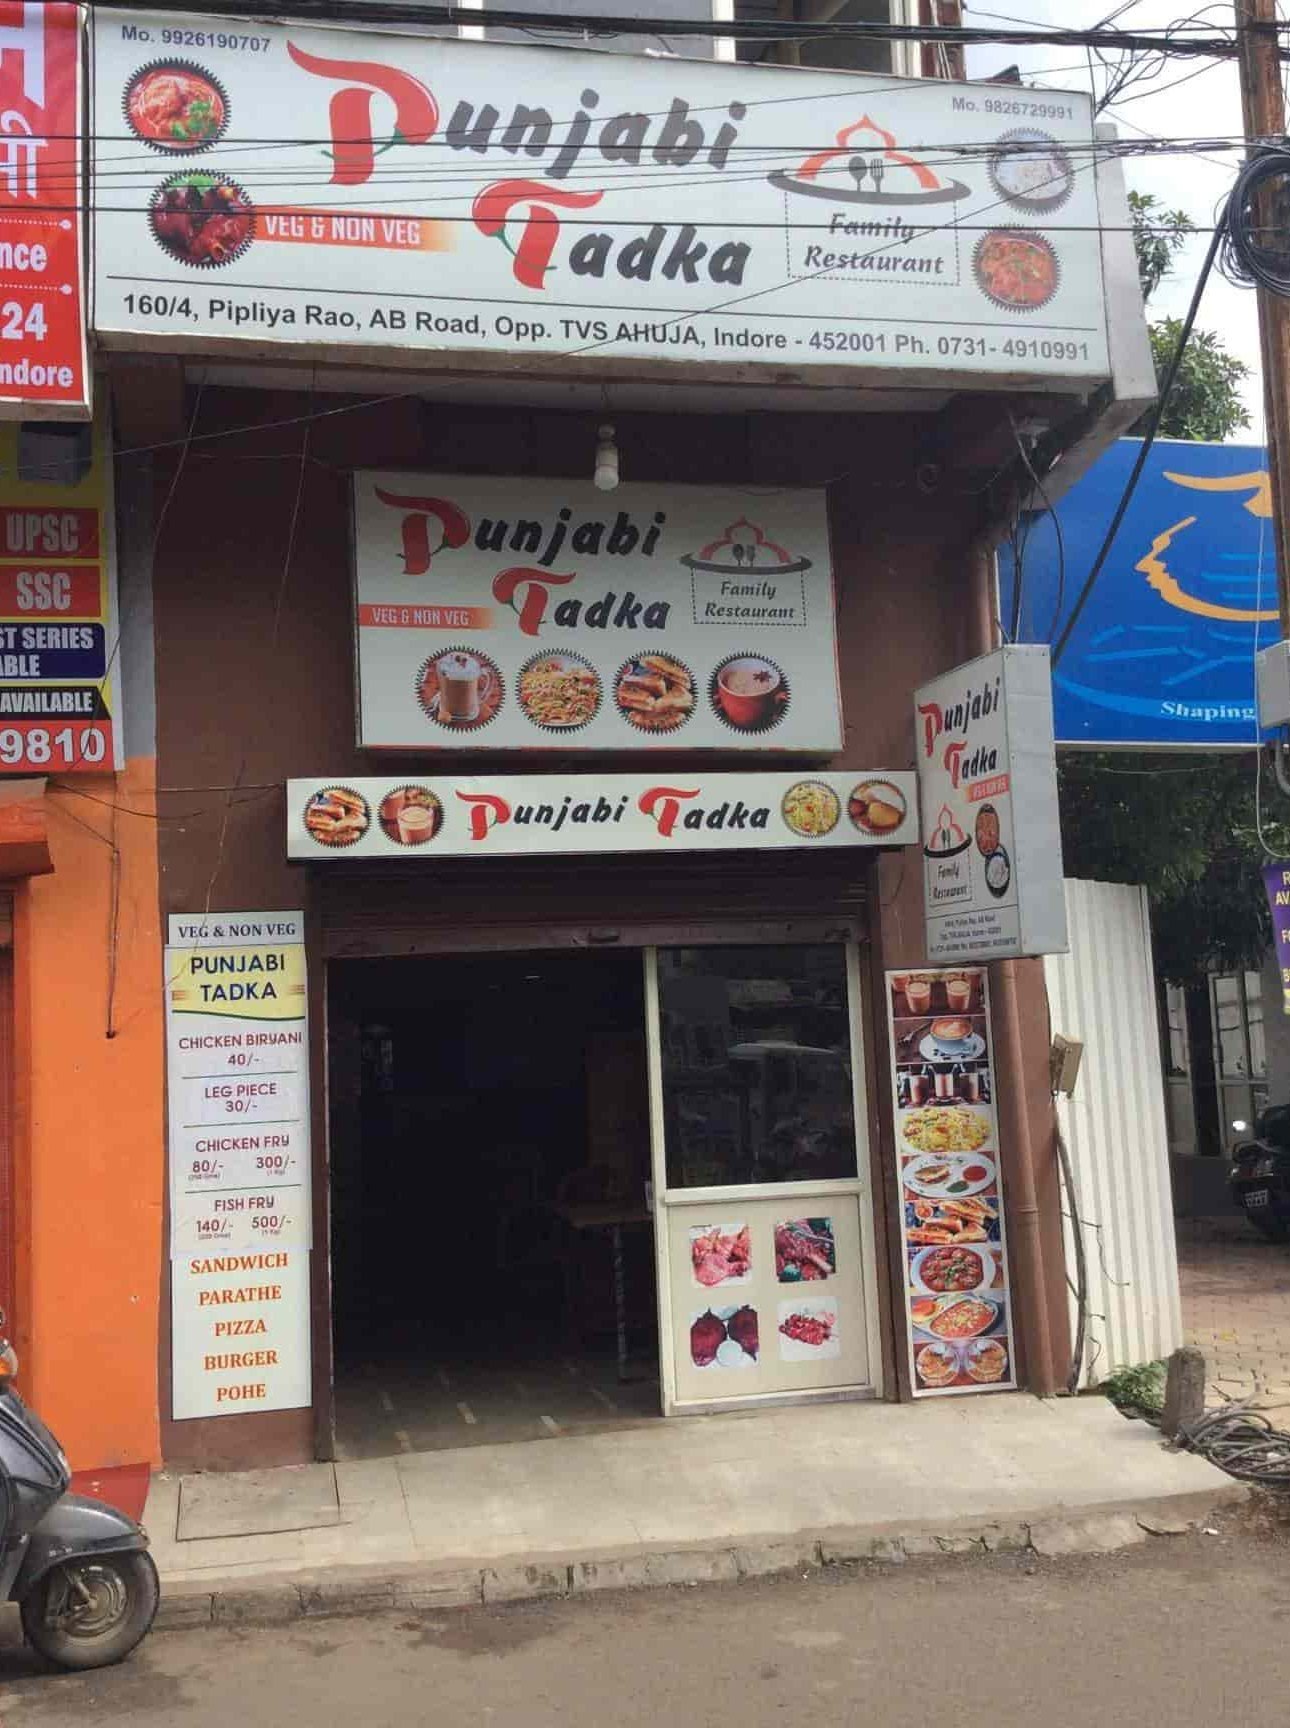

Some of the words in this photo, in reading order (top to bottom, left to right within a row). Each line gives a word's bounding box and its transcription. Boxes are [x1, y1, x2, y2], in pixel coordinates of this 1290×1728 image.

[121, 25, 155, 42] Mo.
[161, 30, 271, 52] 9926190707
[287, 39, 747, 185] Punjabi
[952, 97, 980, 112] Mo.
[984, 99, 1073, 120] 9826729991
[264, 215, 304, 237] VEG
[311, 216, 324, 238] &
[331, 216, 375, 241] NON
[381, 218, 420, 245] VEG
[471, 178, 752, 290] Tadka
[828, 212, 916, 244] Family
[803, 245, 945, 275] Restaurant
[123, 294, 199, 322] 160/4,
[208, 298, 296, 327] Pipliya
[304, 304, 361, 331] Rao,
[369, 309, 407, 330] AB
[415, 311, 487, 338] Road,
[495, 315, 552, 339] Opp.
[560, 320, 608, 341] TVS
[616, 322, 706, 347] AHUJA,
[714, 327, 788, 349] Indore
[809, 331, 887, 353] 452001
[895, 333, 931, 354] Ph.
[1002, 338, 1090, 361] 4910991
[6, 514, 79, 551] UPSC
[373, 486, 667, 575] Punjabi
[16, 572, 71, 610] SSC
[720, 580, 777, 600] Family
[491, 567, 671, 636] Tadka
[704, 602, 795, 620] Restaurant
[372, 608, 397, 624] VEG
[413, 609, 441, 625] NON
[444, 610, 469, 625] VEG
[22, 627, 94, 650] SERIES
[1, 692, 93, 713] AVAILABLE
[1161, 700, 1256, 721] Shaping
[918, 676, 1000, 757] Punjabi
[943, 741, 997, 789] Tadka
[455, 787, 631, 841] Punjabi
[638, 786, 770, 838] Tadka
[178, 925, 209, 938] VEG
[213, 926, 225, 937] &
[229, 925, 263, 937] NON
[266, 923, 296, 936] VEG
[191, 953, 285, 975] PUNJABI
[200, 981, 277, 1002] TADKA
[178, 1034, 243, 1050] CHICKEN
[246, 1032, 302, 1047] BIRYANI
[227, 1053, 260, 1066] 40/-
[204, 1085, 233, 1099] LEG
[236, 1083, 277, 1097] PIECE
[225, 1100, 258, 1113] 30/-
[195, 1139, 260, 1153] CHICKEN
[264, 1135, 290, 1147] FRY
[192, 1159, 224, 1173] 80/-
[256, 1155, 296, 1169] 300/-
[214, 1199, 245, 1212] FISH
[248, 1196, 274, 1209] FRY
[196, 1219, 234, 1233] 140/-
[251, 1215, 292, 1229] 500/-
[190, 1253, 288, 1274] SANDWICH
[199, 1285, 282, 1306] PARATHE
[214, 1319, 267, 1336] PIZZA
[204, 1350, 278, 1370] BURGER
[217, 1384, 266, 1401] POHE
